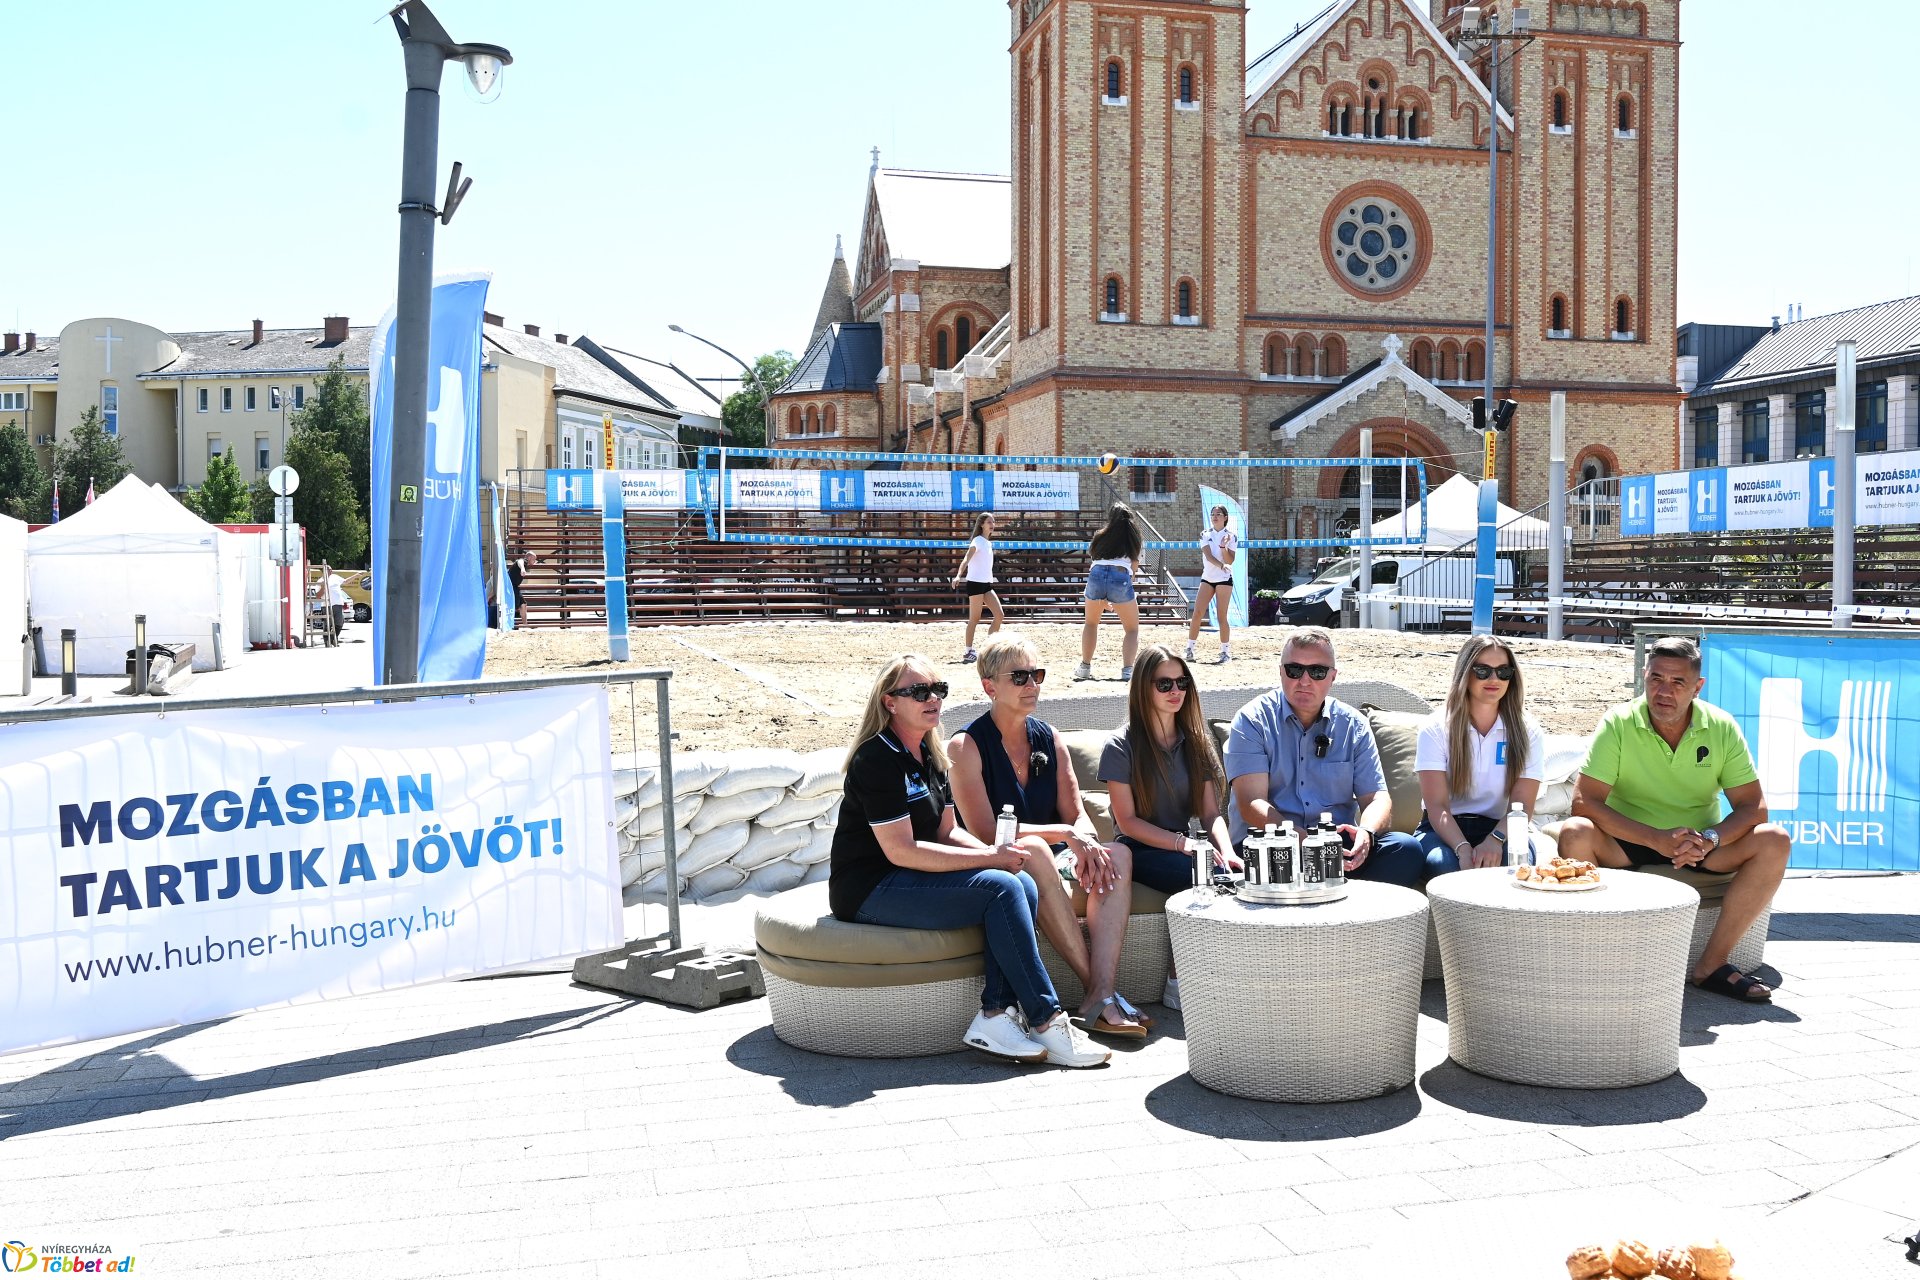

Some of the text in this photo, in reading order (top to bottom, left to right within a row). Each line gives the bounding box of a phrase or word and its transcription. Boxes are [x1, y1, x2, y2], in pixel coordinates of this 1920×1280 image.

[622, 480, 656, 488] GÁSBAN
[740, 480, 792, 488] MOZGÁSBAN
[1733, 480, 1782, 491] MOZGÁSBAN
[1865, 485, 1905, 496] TARTJUK
[1906, 484, 1913, 494] A
[1734, 495, 1766, 504] TARTJUK
[1767, 494, 1773, 502] A
[58, 773, 435, 848] MOZGÁSBAN
[1769, 821, 1885, 846] ÜBNER
[1272, 850, 1289, 860] 383
[60, 813, 566, 919] TARTJUK A JÖVŐT!
[64, 905, 457, 983] www.hubner-hungary.hu
